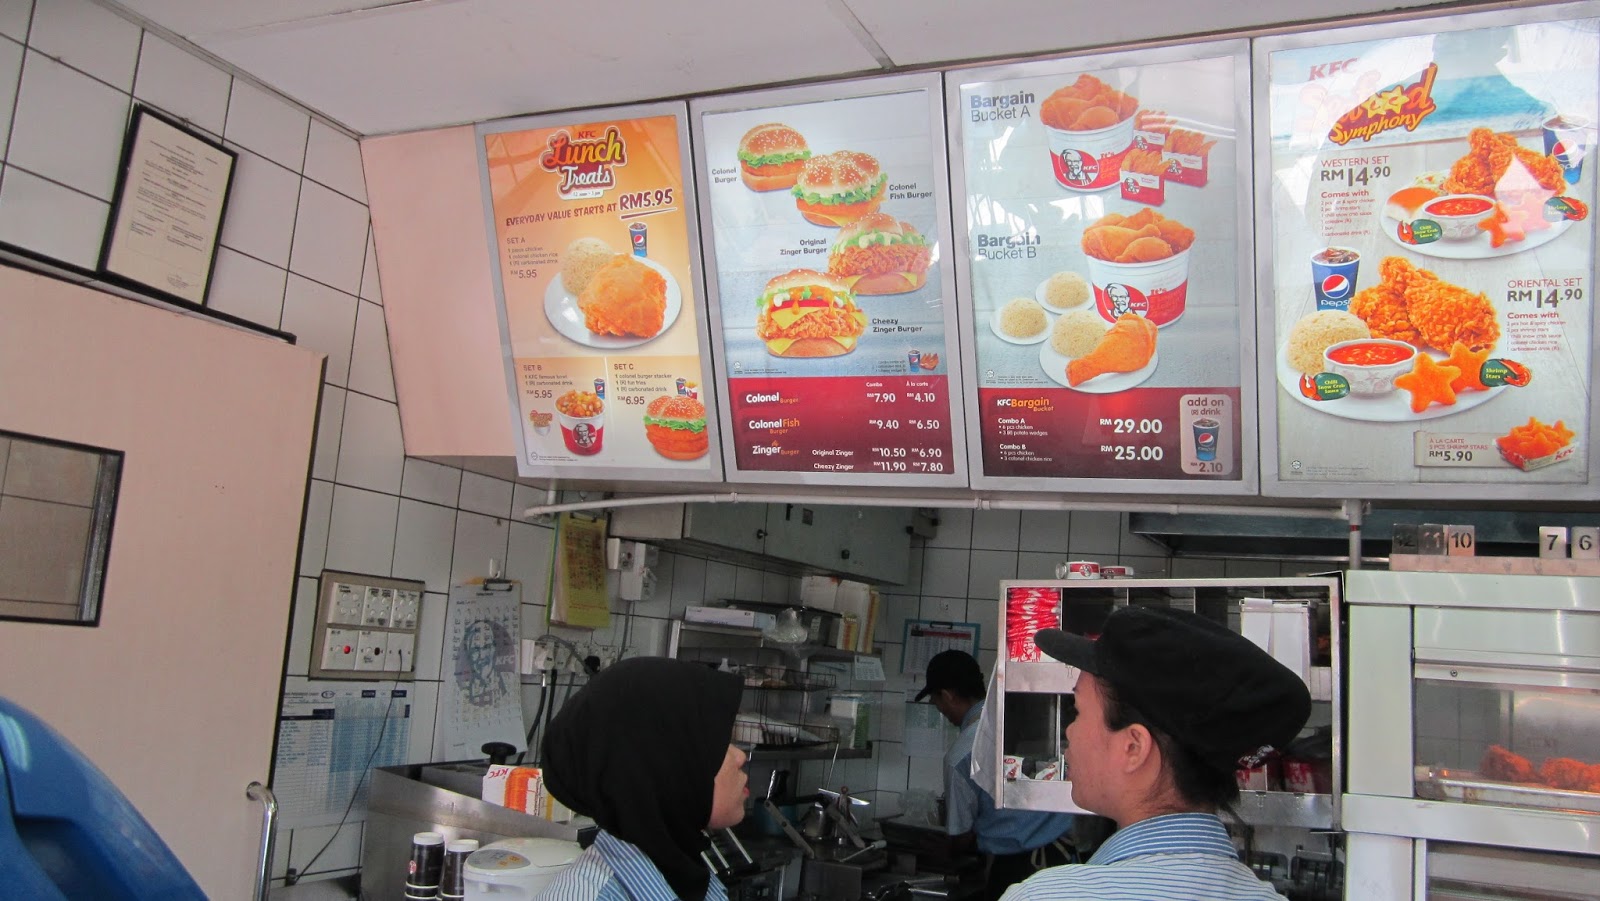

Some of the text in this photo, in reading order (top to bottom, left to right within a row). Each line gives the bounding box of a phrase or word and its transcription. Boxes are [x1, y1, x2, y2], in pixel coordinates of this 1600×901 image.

[1309, 58, 1359, 81] KFC
[970, 91, 1035, 108] Bargain
[971, 104, 1031, 122] Bucket A
[1329, 104, 1436, 144] Symphony
[544, 131, 622, 166] Lunch
[1321, 156, 1389, 167] WESTERN SET
[561, 165, 611, 190] Treats
[715, 176, 737, 184] Burger
[889, 183, 916, 191] Colonel
[906, 190, 932, 200] Burger
[506, 188, 673, 227] EVERYDAY VALUE STARTS AT RM5.95
[800, 238, 827, 247] Original
[977, 233, 1041, 249] Bargain
[780, 247, 827, 256] Zinger Burger
[978, 246, 1037, 261] Bucket B
[1508, 278, 1582, 288] ORIENTAL SET
[898, 325, 923, 334] Burger
[746, 392, 779, 403] Colonel
[1188, 397, 1207, 406] add
[1114, 419, 1162, 433] 29.00
[752, 445, 781, 456] Zinger
[1115, 446, 1163, 460] 25.00
[814, 463, 835, 471] Cheezy
[1451, 532, 1472, 548] 10
[1547, 534, 1559, 550] 7
[1579, 535, 1592, 551] 6
[495, 656, 515, 665] KFC
[488, 768, 509, 779] KFC
